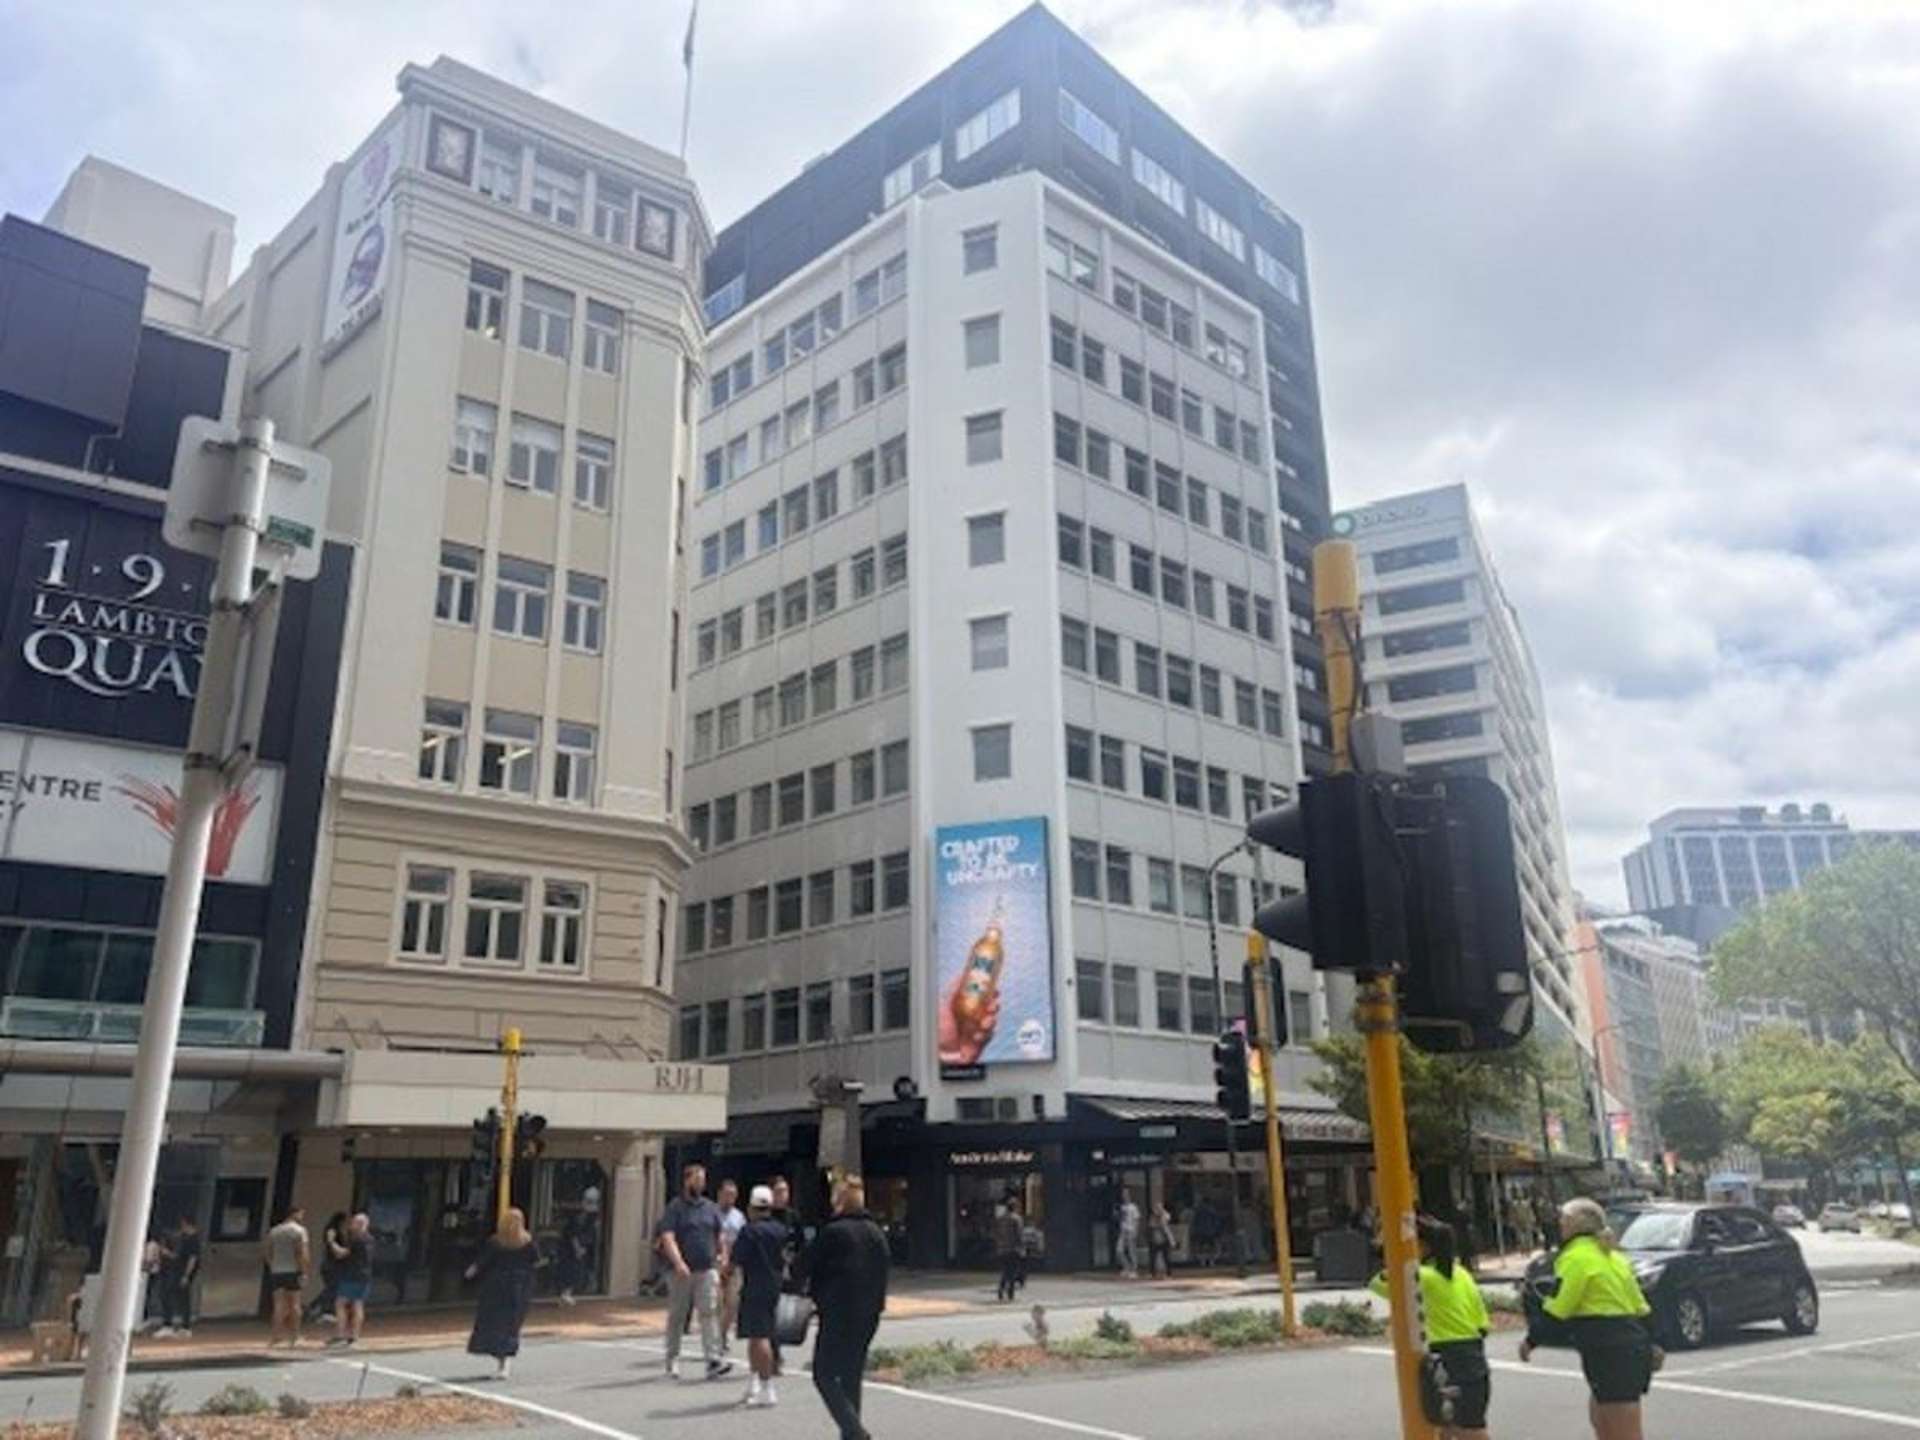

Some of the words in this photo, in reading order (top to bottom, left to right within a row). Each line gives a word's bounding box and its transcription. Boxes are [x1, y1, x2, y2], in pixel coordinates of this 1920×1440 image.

[33, 594, 208, 646] LAMBTO
[23, 627, 205, 699] QUA
[0, 769, 102, 802] ENTRE
